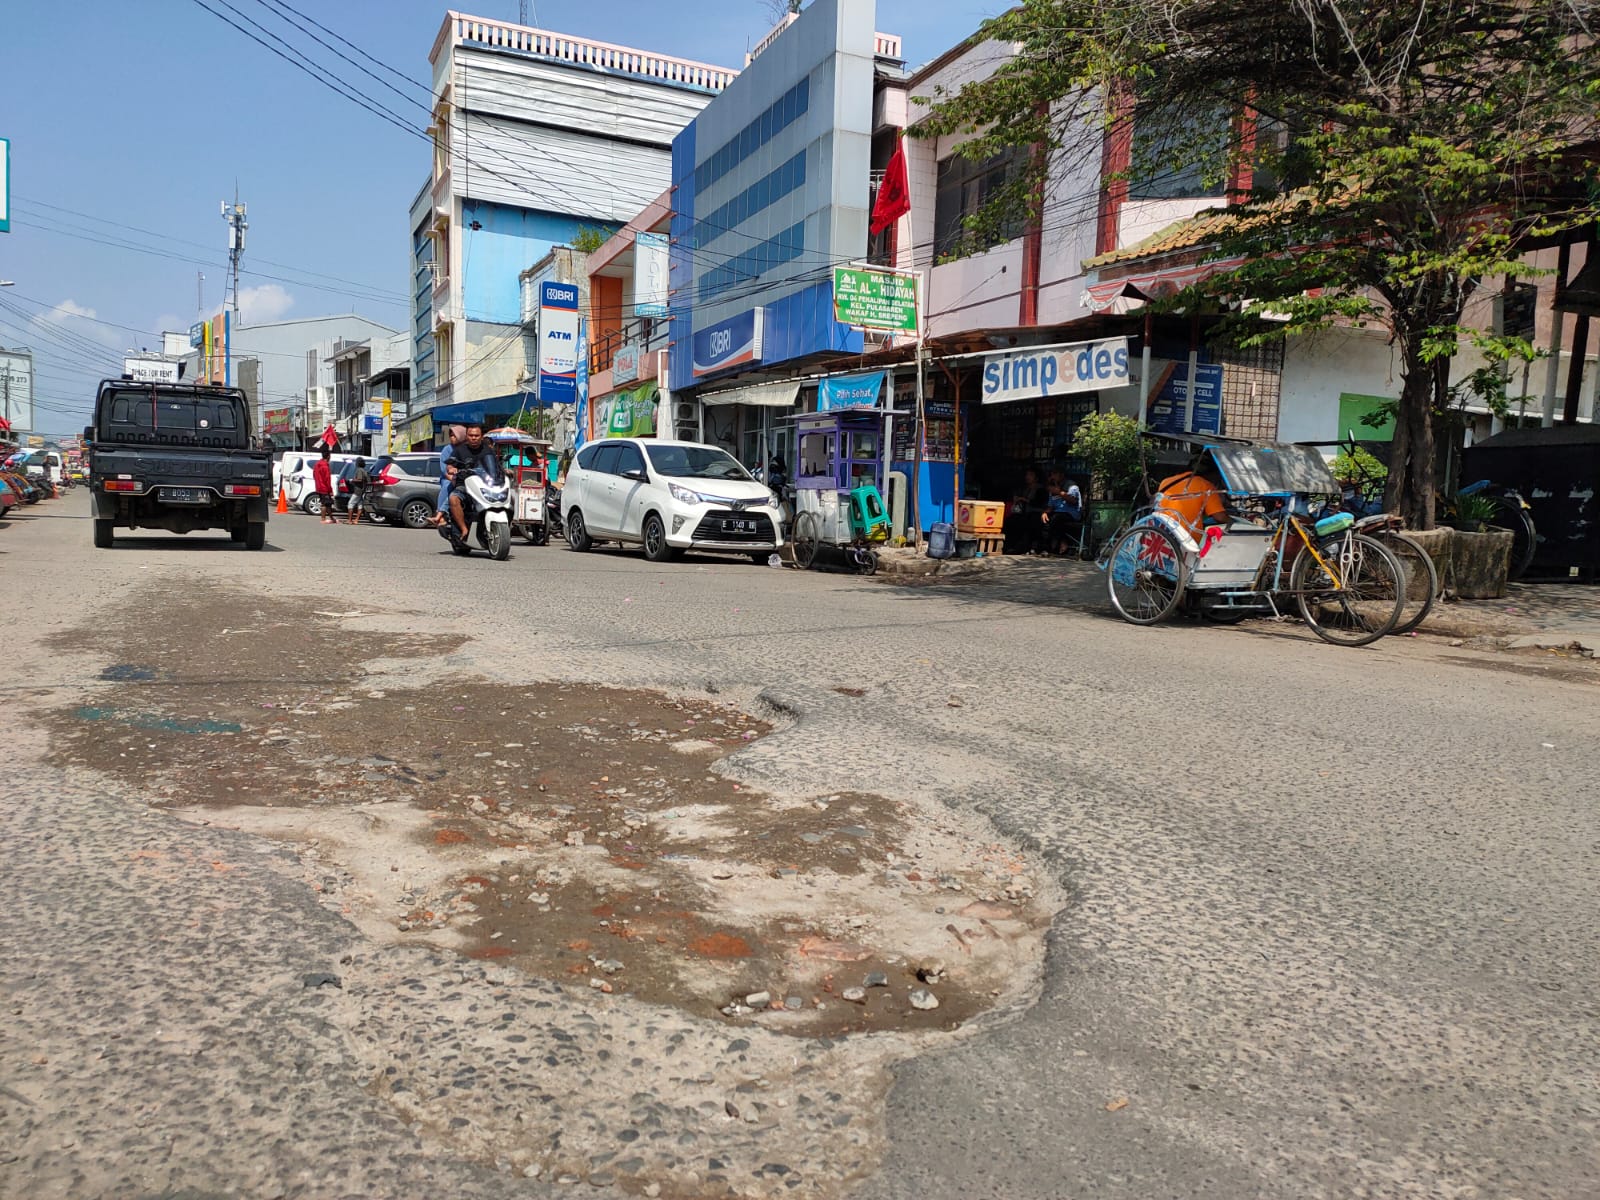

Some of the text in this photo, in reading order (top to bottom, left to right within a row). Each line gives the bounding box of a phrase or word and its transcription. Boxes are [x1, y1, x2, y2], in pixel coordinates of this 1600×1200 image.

[870, 275, 904, 286] MASJID
[860, 282, 871, 294] AL
[880, 283, 915, 299] HIDAYAH
[845, 308, 868, 317] WAKAF
[548, 330, 572, 341] ATM
[983, 342, 1129, 397] simpedes
[1197, 388, 1213, 397] CELL
